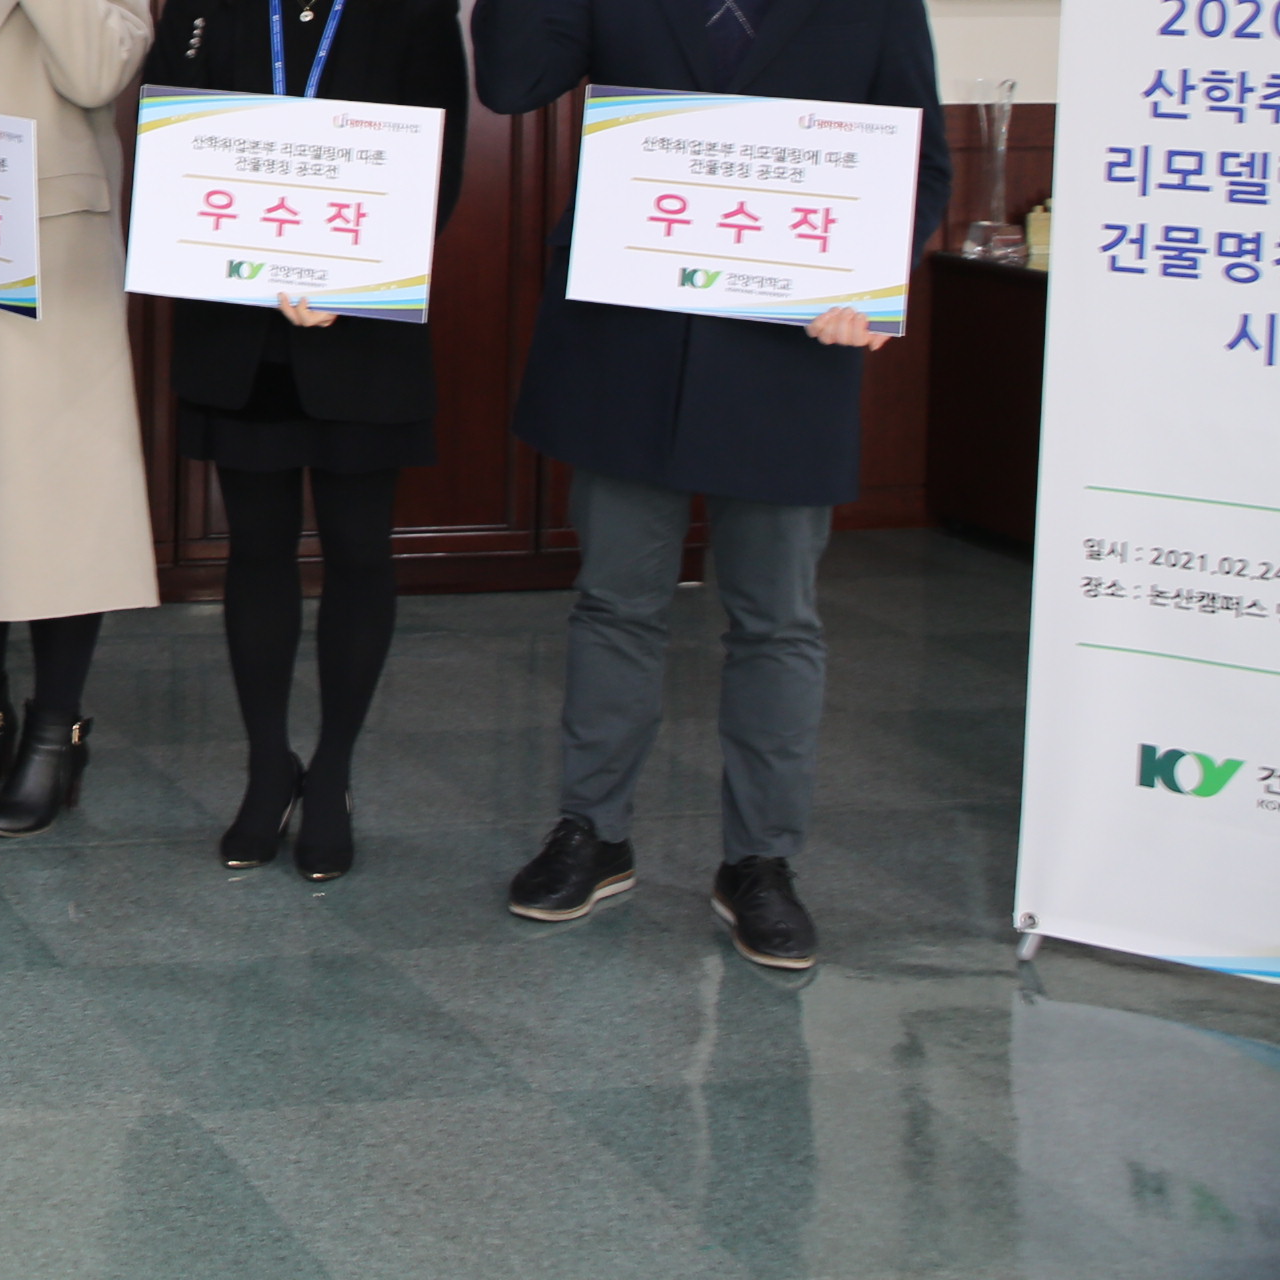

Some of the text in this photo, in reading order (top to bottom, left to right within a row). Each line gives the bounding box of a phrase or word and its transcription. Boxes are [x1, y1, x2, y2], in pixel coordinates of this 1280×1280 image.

[192, 135, 386, 165] 산학취업본부 리모델링에 따른
[642, 136, 859, 168] 산학취업본부 리모델링에 따른
[235, 157, 339, 179] 건물명칭 공모전
[689, 159, 805, 183] 건물명칭 공모전
[1105, 144, 1280, 205] 리모델
[1098, 223, 1280, 284] 건물명
[1083, 538, 1128, 564] 일시
[1080, 576, 1126, 598] 장소
[1147, 584, 1269, 618] 논산캠퍼스
